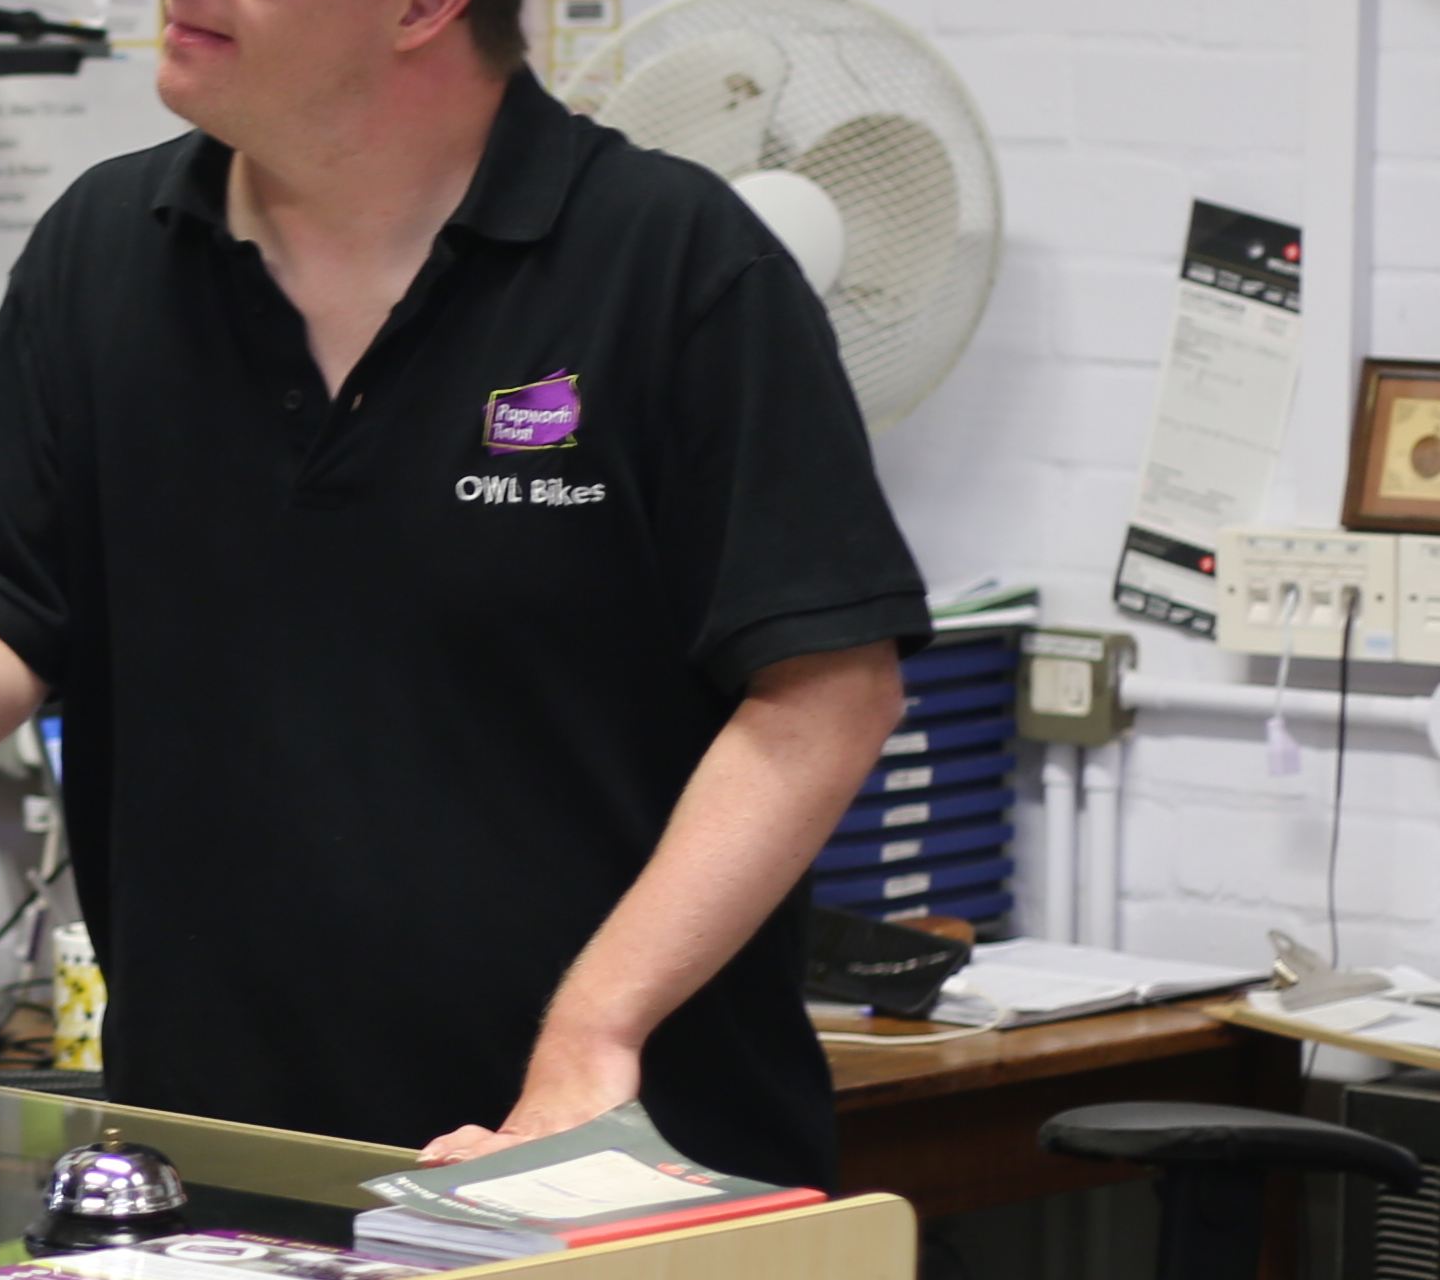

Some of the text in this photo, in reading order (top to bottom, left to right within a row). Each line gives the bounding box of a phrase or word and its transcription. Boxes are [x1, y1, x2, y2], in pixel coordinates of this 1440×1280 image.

[494, 403, 573, 428] Papworth
[454, 474, 607, 507] OWL Bikes
